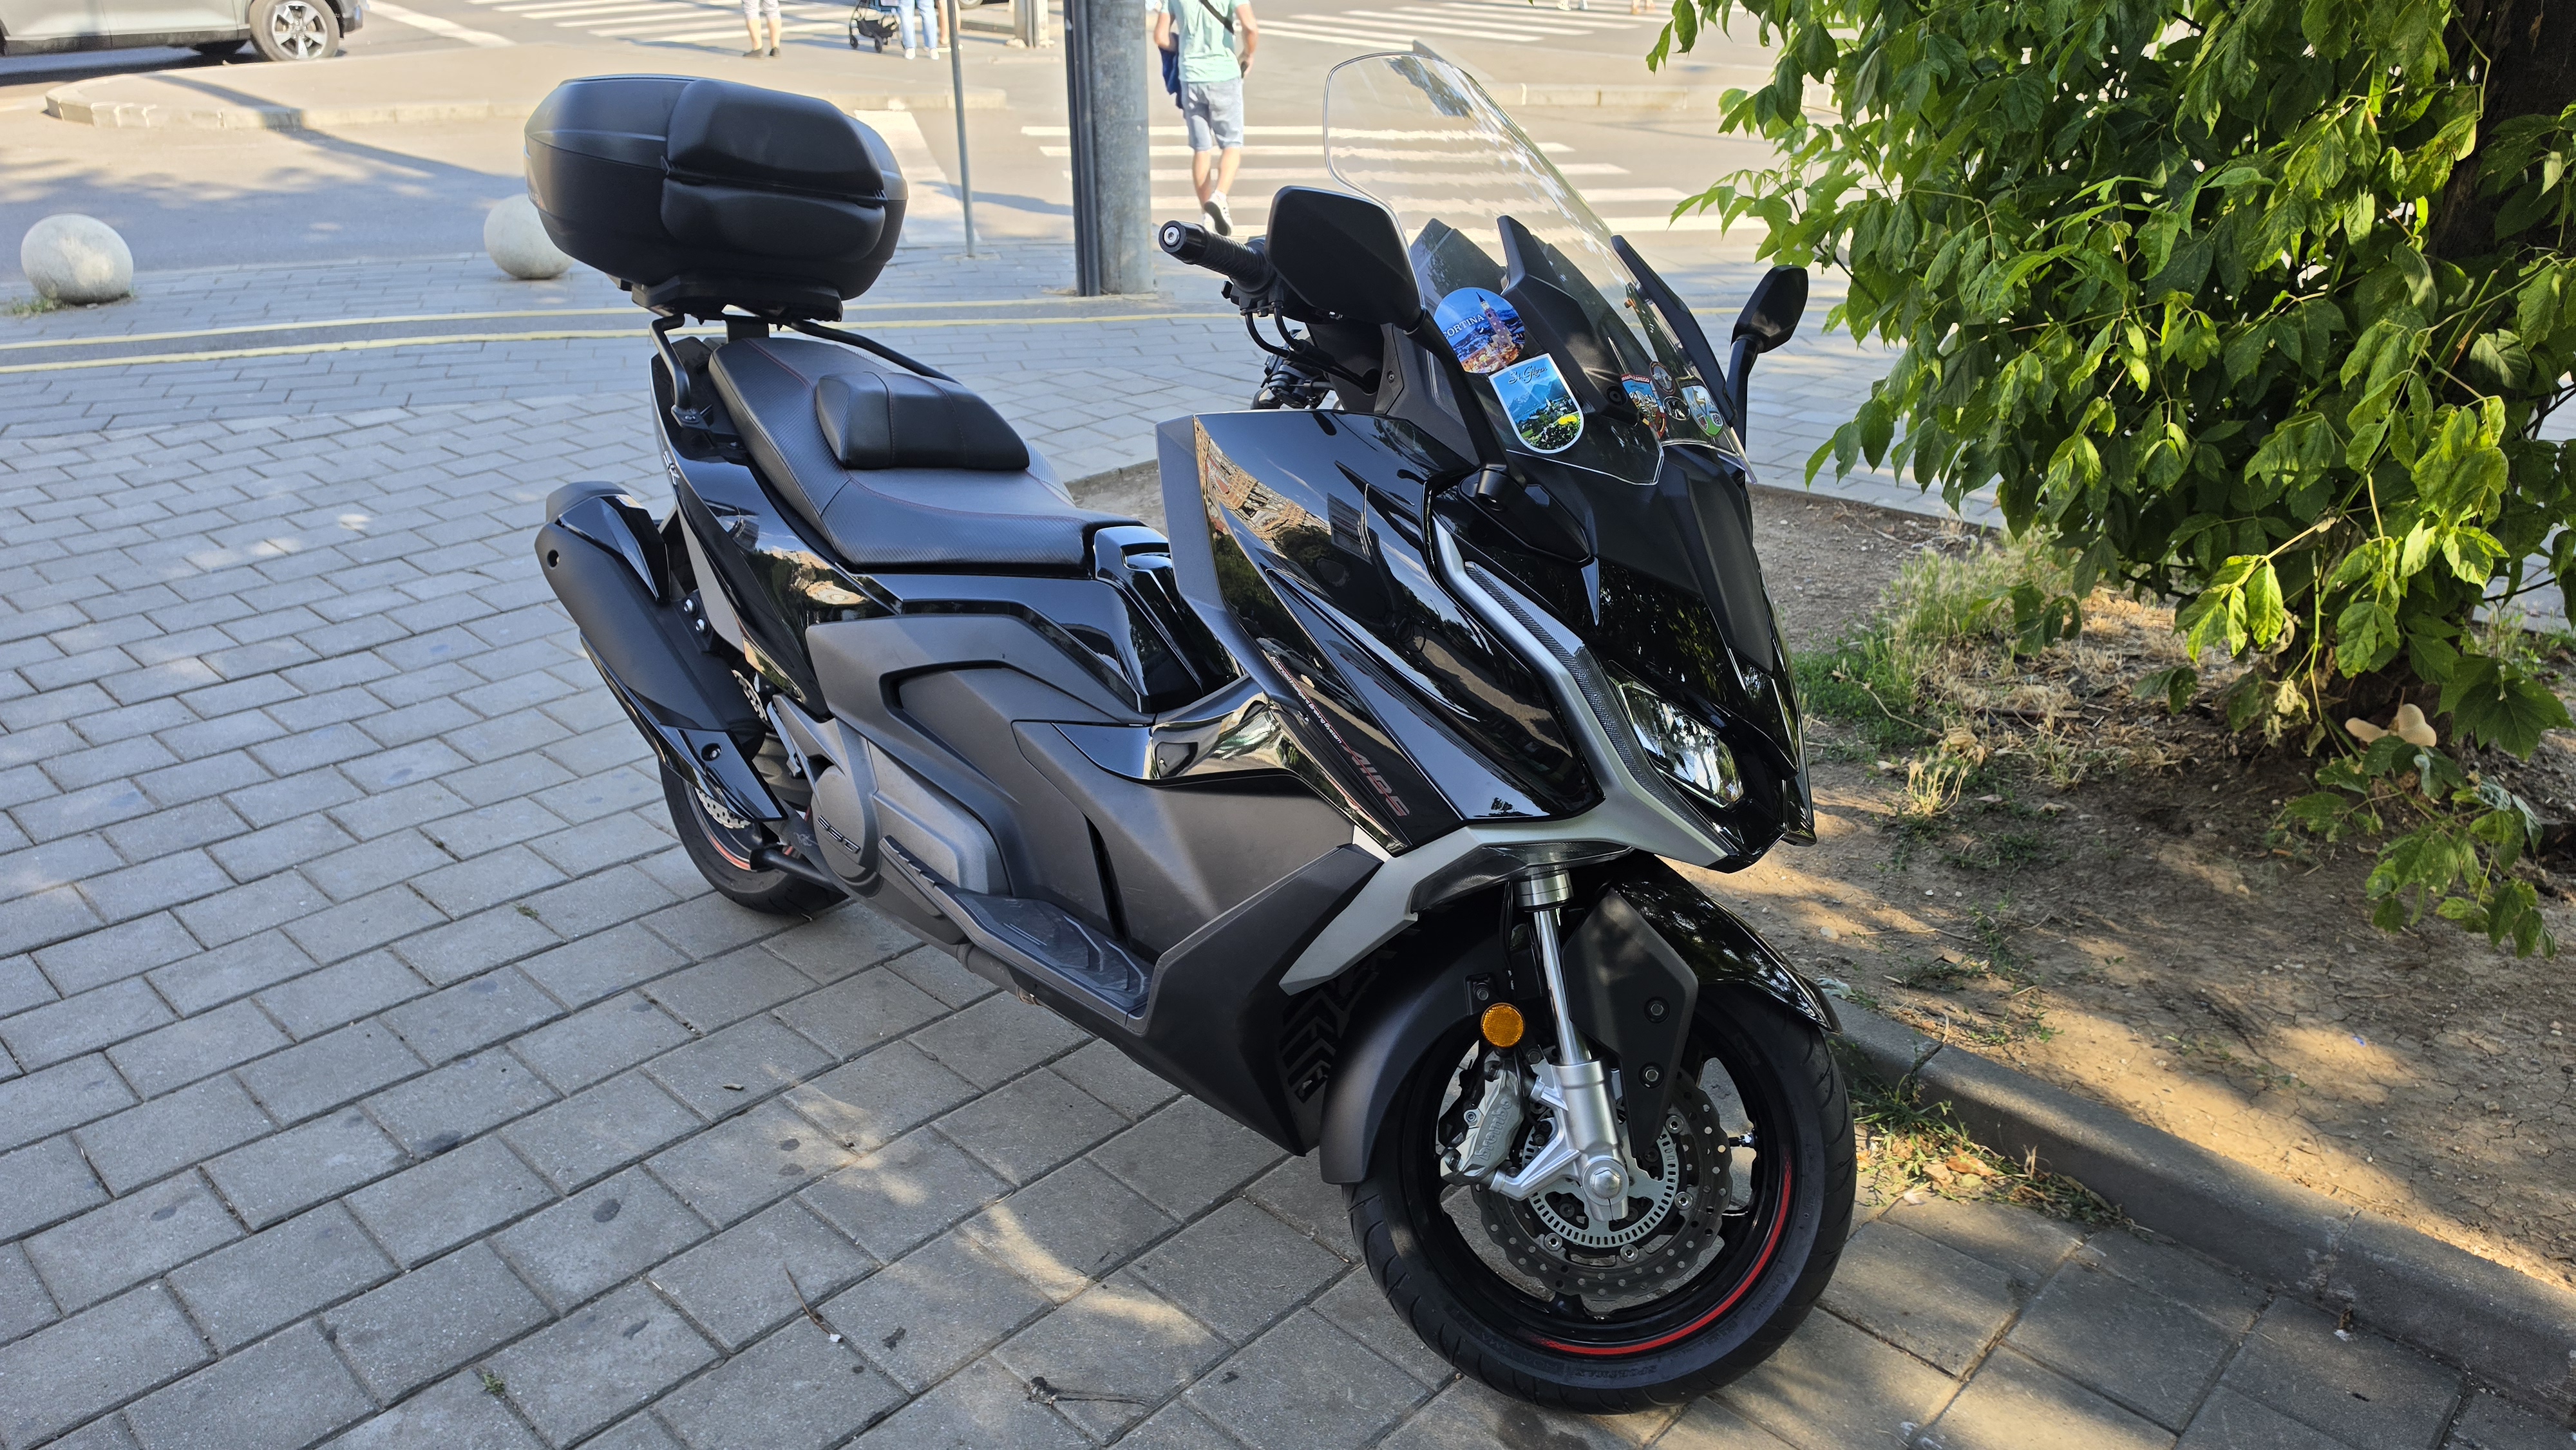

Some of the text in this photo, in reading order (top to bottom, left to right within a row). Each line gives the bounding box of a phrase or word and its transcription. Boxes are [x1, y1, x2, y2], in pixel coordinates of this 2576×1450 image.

[1443, 314, 1485, 339] CORTINA
[1270, 656, 1342, 744] Advanced Intelligent Braking System
[1474, 1097, 1512, 1161] brembo
